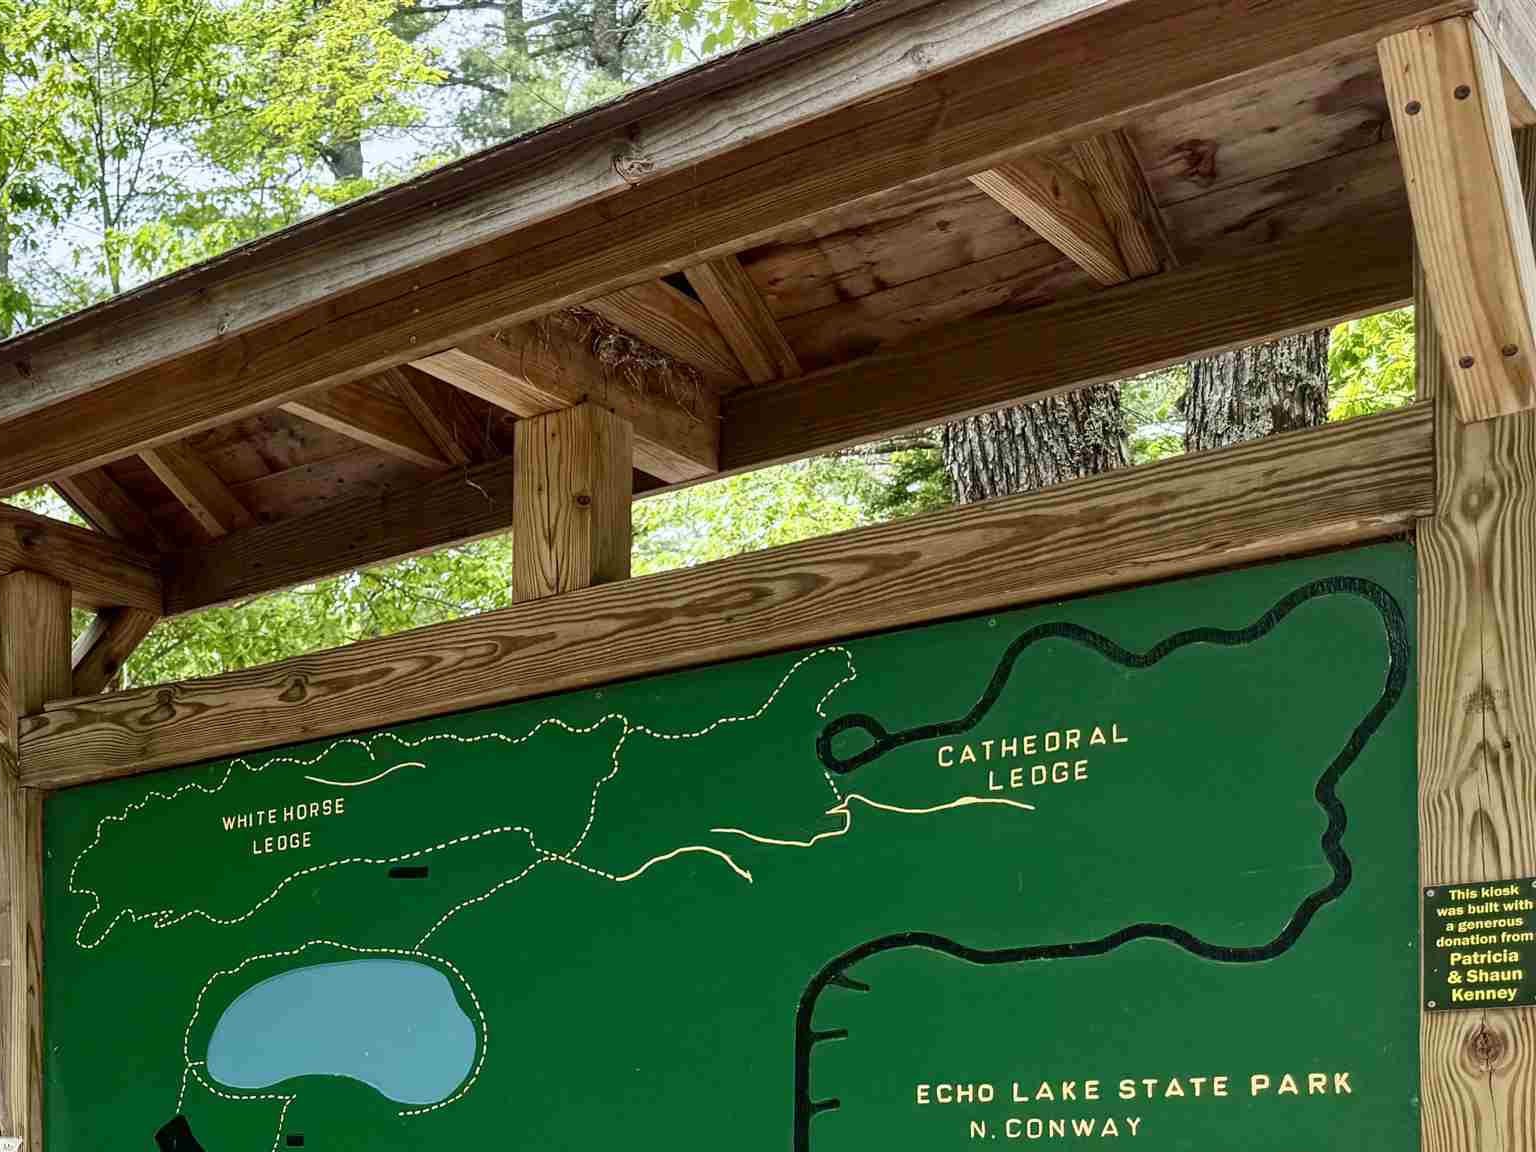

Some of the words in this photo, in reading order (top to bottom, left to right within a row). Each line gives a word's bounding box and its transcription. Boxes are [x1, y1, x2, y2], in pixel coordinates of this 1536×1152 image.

[938, 723, 1128, 767] CATHEDRAL
[988, 759, 1088, 791] LEDGE
[222, 808, 277, 831] WHITE
[283, 797, 344, 822] HORSE
[253, 831, 311, 854] LEDGE
[1448, 888, 1478, 900] This
[1481, 885, 1520, 898] kiosk
[1436, 905, 1464, 917] was
[1468, 902, 1500, 914] built
[1503, 899, 1534, 912] with
[1446, 922, 1454, 932] a
[1457, 917, 1524, 933] generous
[1436, 934, 1497, 948] donation
[1501, 931, 1534, 943] from
[1450, 949, 1519, 966] Patricia
[1447, 970, 1462, 984] &
[1466, 968, 1523, 983] Shaun
[1451, 987, 1518, 1002] Kenney
[916, 1083, 995, 1104] ECHO
[1012, 1080, 1100, 1102] LAKE
[1119, 1076, 1229, 1100] STATE
[1250, 1071, 1353, 1097] PARK
[1005, 1116, 1142, 1139] CONWAY
